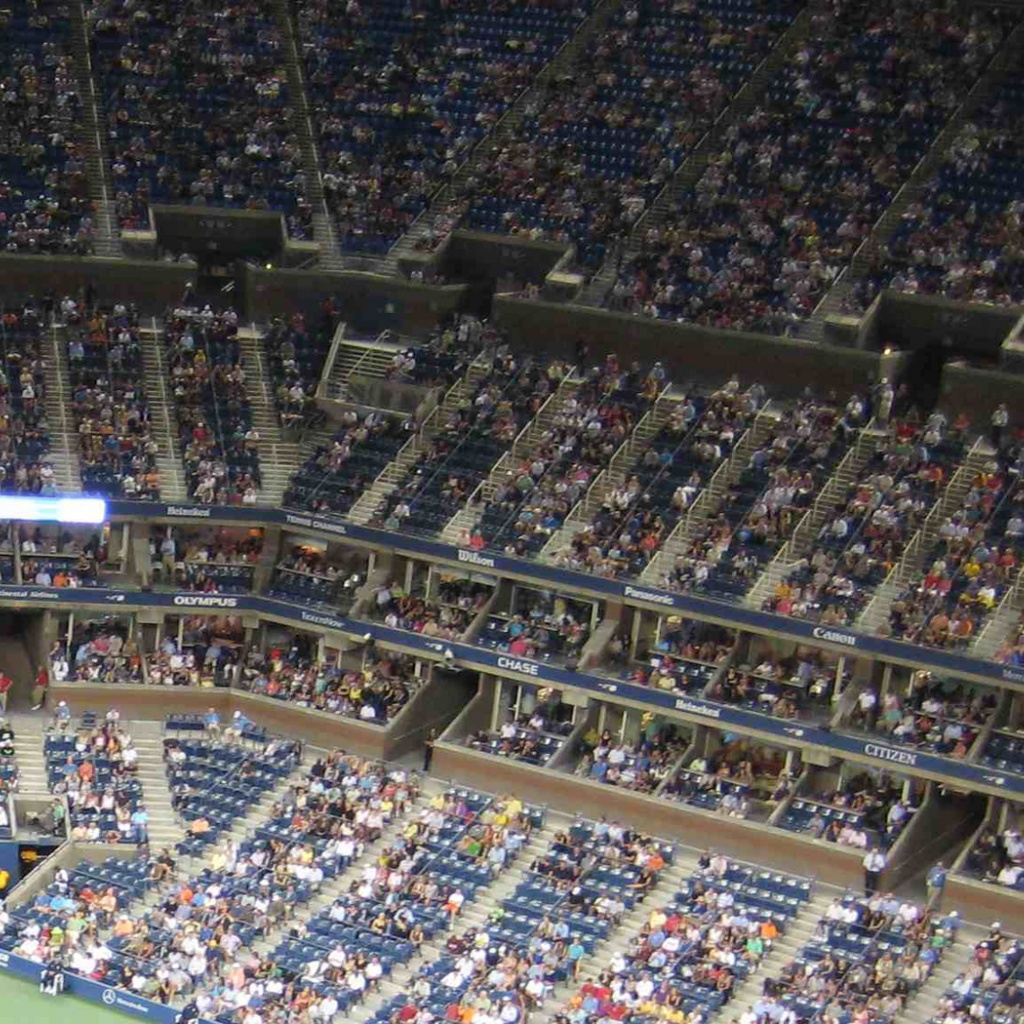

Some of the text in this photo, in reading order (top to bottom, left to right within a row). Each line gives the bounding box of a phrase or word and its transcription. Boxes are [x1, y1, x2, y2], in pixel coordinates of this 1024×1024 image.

[167, 505, 210, 517] Heineken
[458, 549, 494, 567] Wilson
[29, 591, 59, 599] Airlines
[173, 595, 238, 607] OLYMPUS
[624, 586, 674, 605] Panasonic
[813, 626, 856, 646] Canon
[497, 657, 539, 675] CHASE
[675, 699, 720, 718] Heineken
[864, 743, 918, 765] CITIZEN
